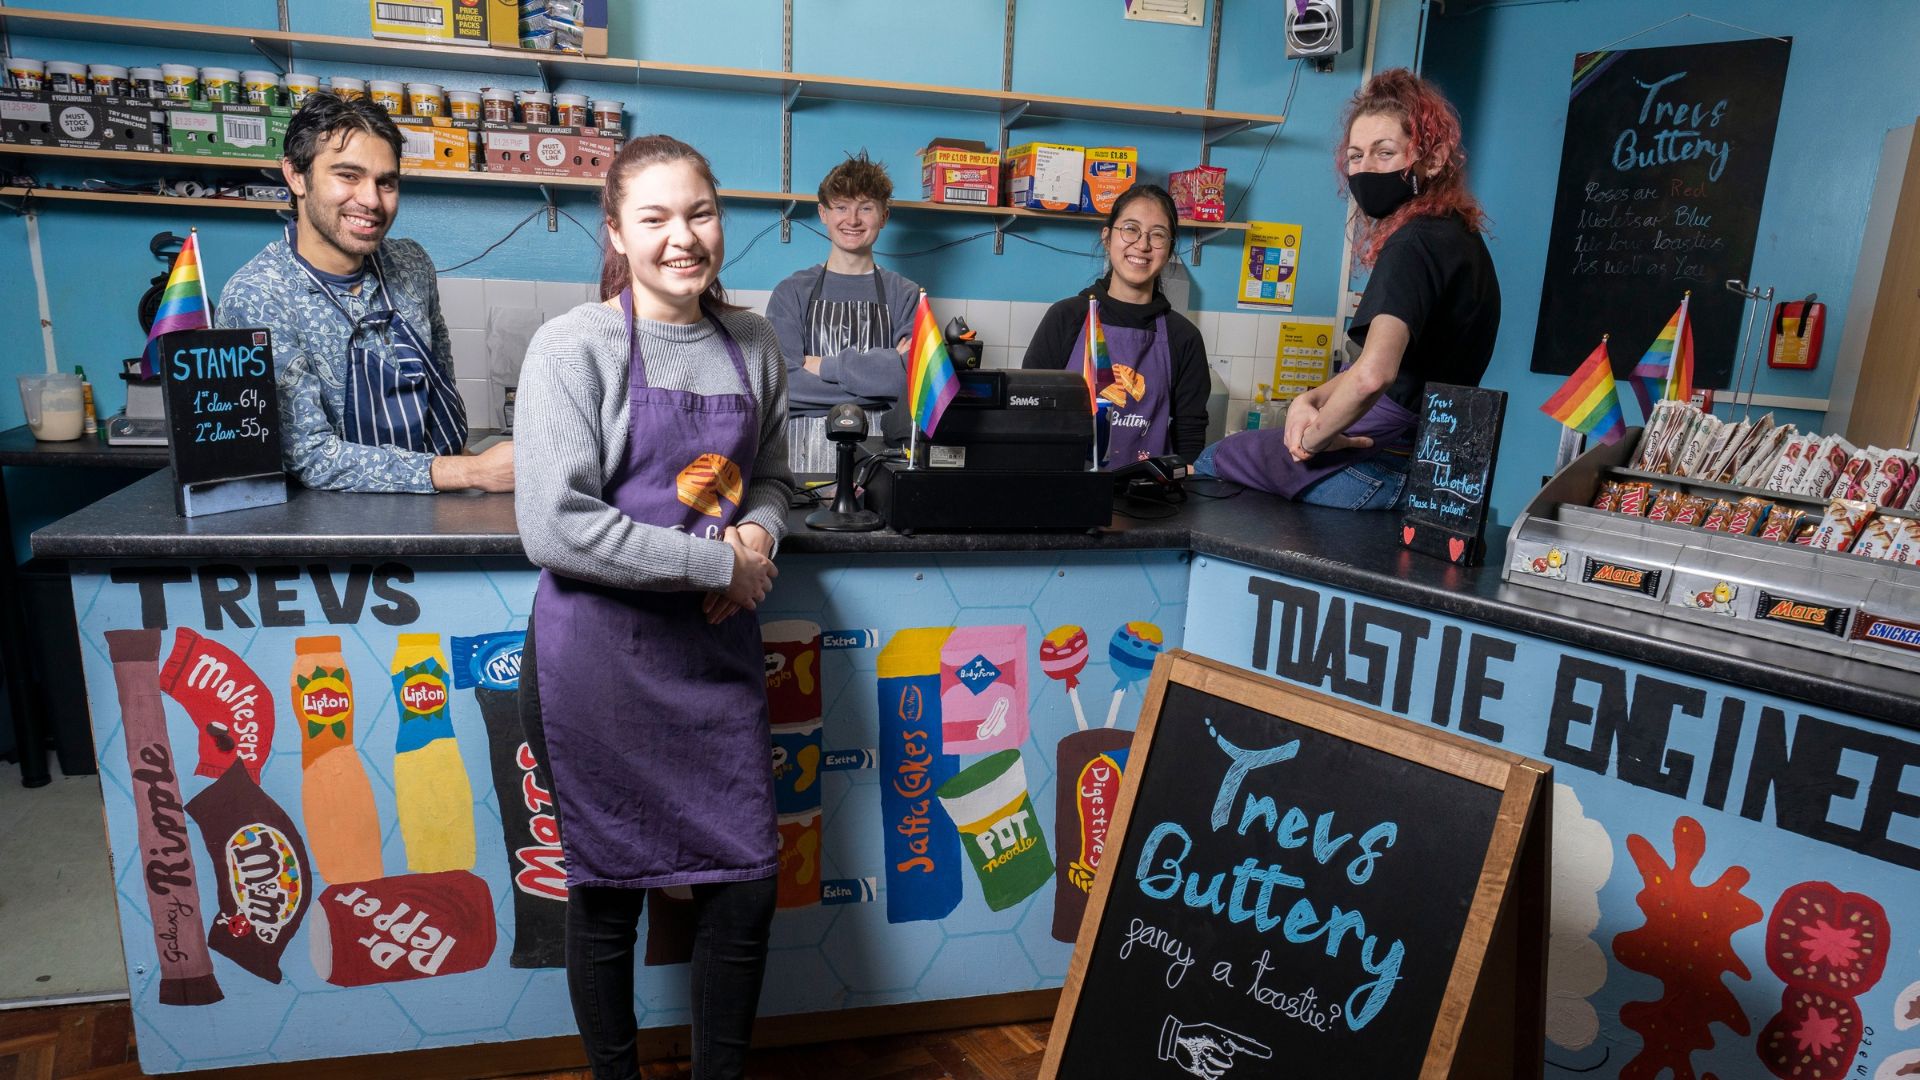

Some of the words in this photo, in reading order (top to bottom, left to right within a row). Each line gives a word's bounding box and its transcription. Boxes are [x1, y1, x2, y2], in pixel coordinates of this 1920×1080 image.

[456, 14, 482, 23] MARKED
[459, 22, 480, 30] PACKS
[167, 84, 191, 97] POT
[131, 114, 148, 123] NEAR
[416, 102, 439, 113] POT
[108, 117, 147, 130] SANDWICHES
[578, 145, 611, 157] SANDWICHES
[939, 152, 951, 161] PMP
[969, 155, 981, 163] PMP
[1110, 151, 1128, 160] £1.85
[1611, 129, 1731, 182] Buttery
[1585, 181, 1630, 202] Roses
[1670, 178, 1708, 198] Red
[1675, 205, 1713, 228] Blue
[173, 346, 267, 381] STAMPS
[1112, 410, 1151, 437] Buttery
[1429, 409, 1457, 435] Buttery
[1418, 436, 1450, 463] New
[1408, 494, 1428, 509] Please
[1429, 498, 1438, 510] be
[1820, 526, 1834, 550] ueno
[1594, 565, 1643, 584] Mars
[110, 562, 421, 630] TREVS
[1769, 600, 1828, 622] Mars
[823, 634, 857, 647] Extra
[1248, 575, 1518, 744] TOASTIE
[186, 652, 260, 763] Maltesers
[303, 693, 350, 714] Lipton
[403, 686, 446, 708] Lipton
[825, 753, 858, 766] Extra
[1205, 718, 1398, 886] Trevs
[133, 742, 194, 897] Ripple
[896, 799, 935, 873] Jaffa
[976, 810, 1031, 859] POT
[983, 836, 1038, 873] noodle
[823, 885, 853, 899] Extra
[162, 895, 194, 963] Galaxy
[335, 888, 457, 976] Pepper
[1136, 822, 1405, 1032] Buttery
[357, 934, 408, 971] Dr
[1212, 961, 1234, 987] a
[1852, 1026, 1875, 1080] mato
